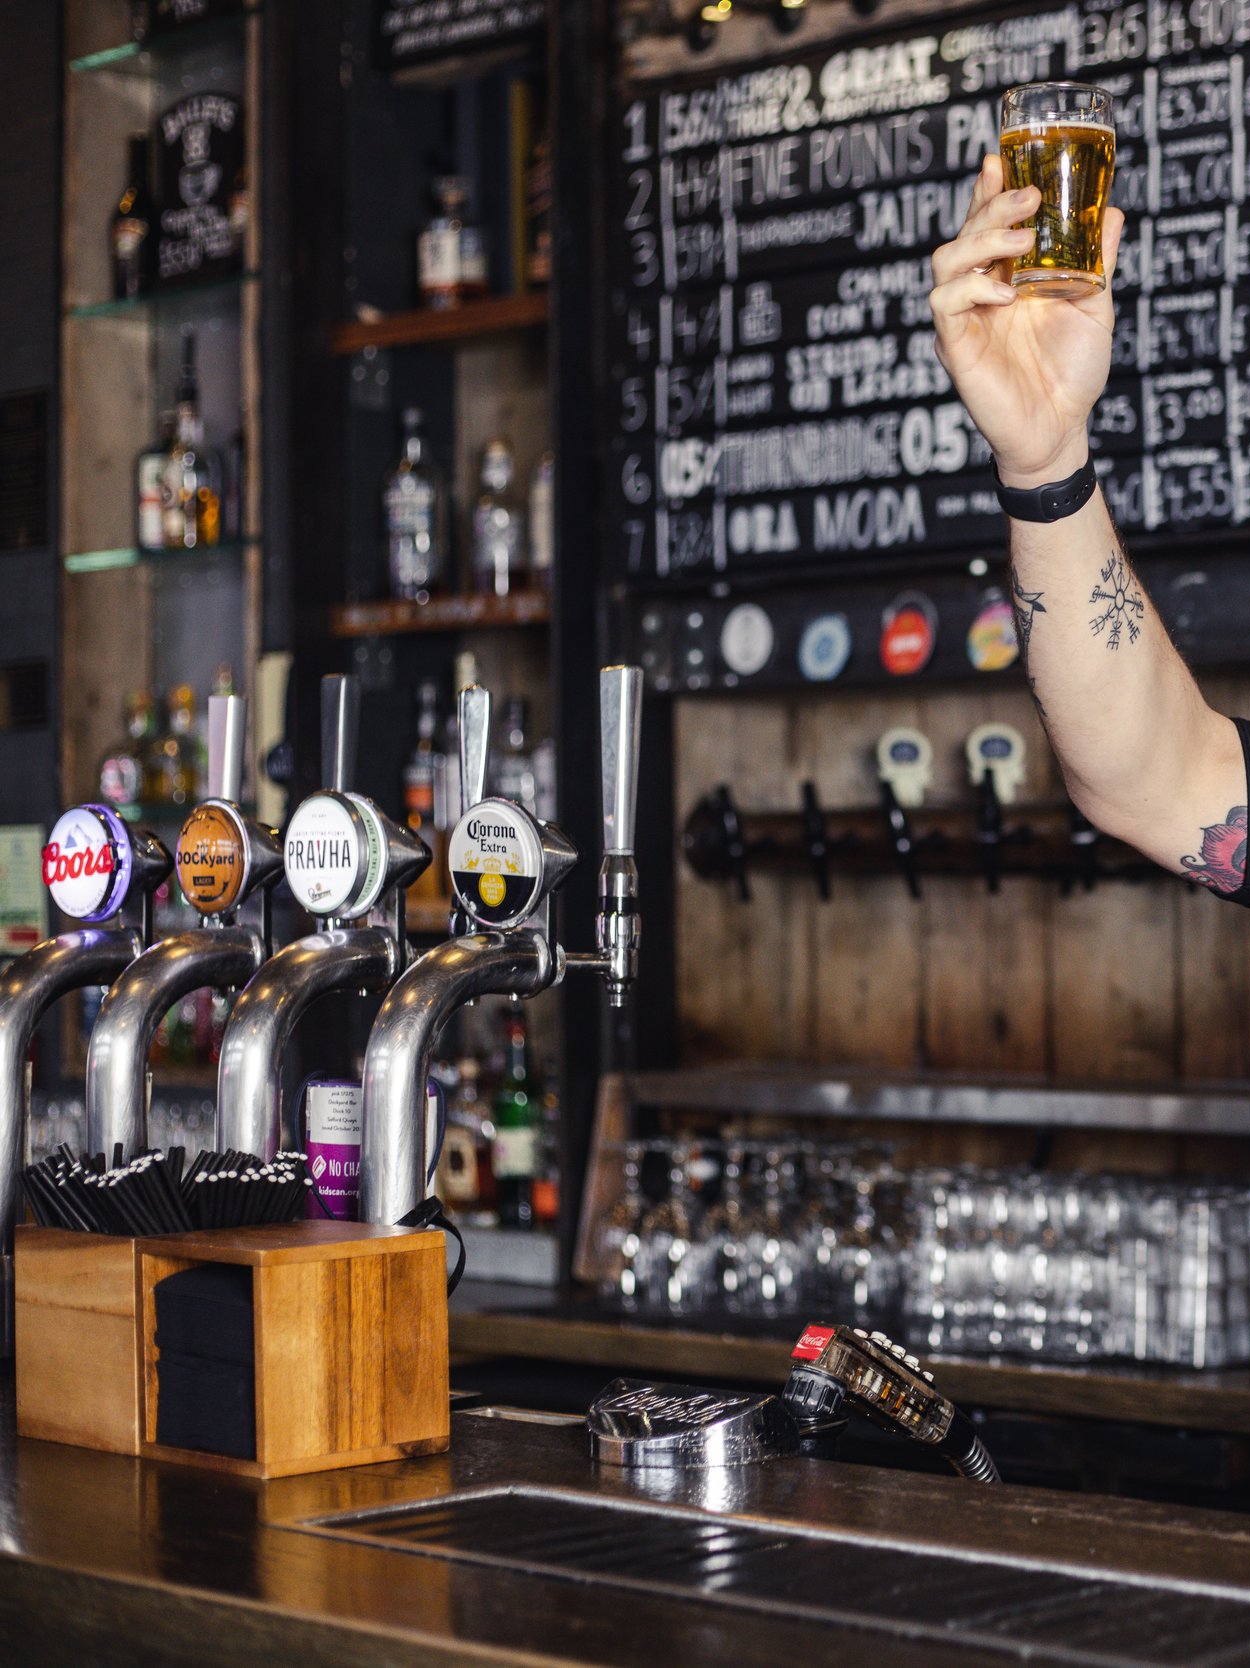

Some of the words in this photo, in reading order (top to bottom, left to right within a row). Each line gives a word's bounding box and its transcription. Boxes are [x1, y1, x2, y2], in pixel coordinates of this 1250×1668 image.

[624, 169, 653, 231] 2
[728, 137, 800, 205] FIVE
[809, 109, 933, 194] POINTS
[630, 231, 659, 286] 3
[855, 172, 976, 250] JAIPU
[620, 377, 647, 432] 5
[622, 453, 651, 505] 6
[814, 484, 926, 551] MODA
[467, 819, 516, 842] Corona
[480, 839, 507, 853] Extra
[42, 843, 114, 886] Coors
[288, 840, 351, 869] PRAVHA
[329, 1158, 341, 1177] NO
